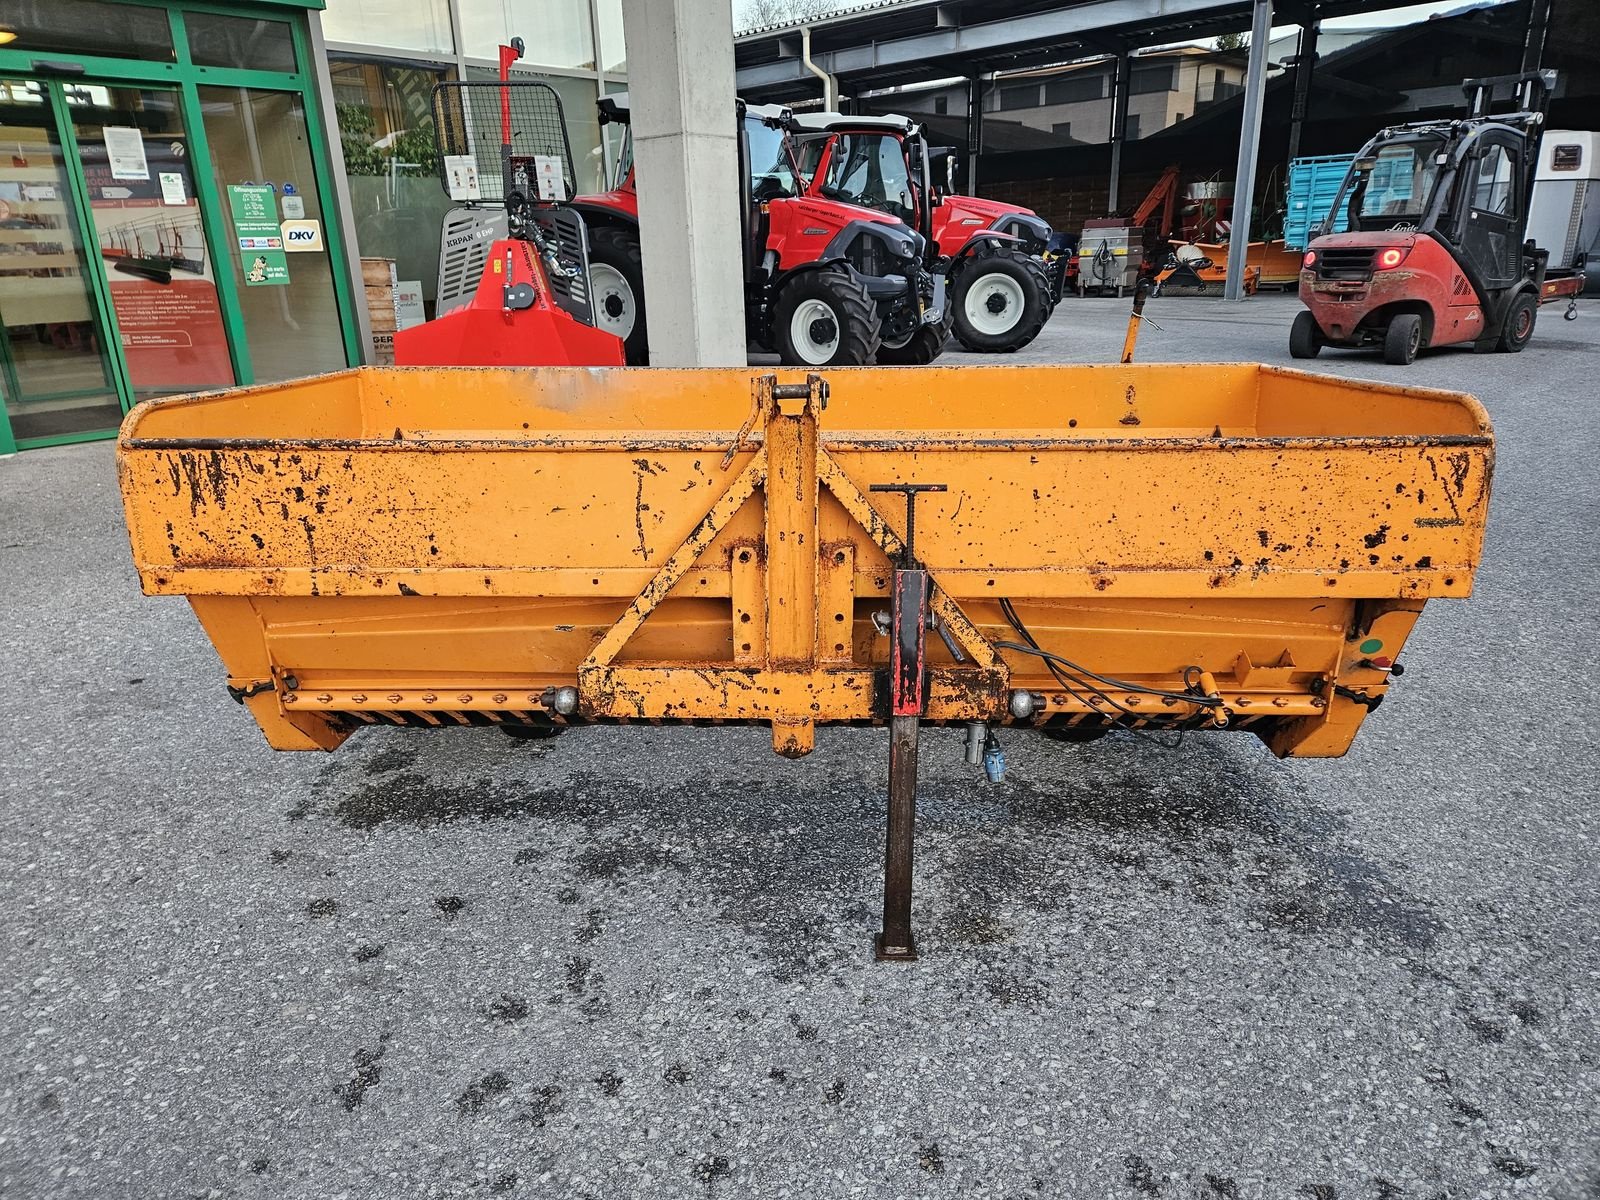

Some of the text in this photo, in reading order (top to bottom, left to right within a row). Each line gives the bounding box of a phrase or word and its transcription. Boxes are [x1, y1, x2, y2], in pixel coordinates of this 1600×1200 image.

[1385, 221, 1419, 232] Linde
[288, 231, 315, 240] DKV
[446, 234, 474, 248] KRPAN
[481, 227, 494, 237] EHP
